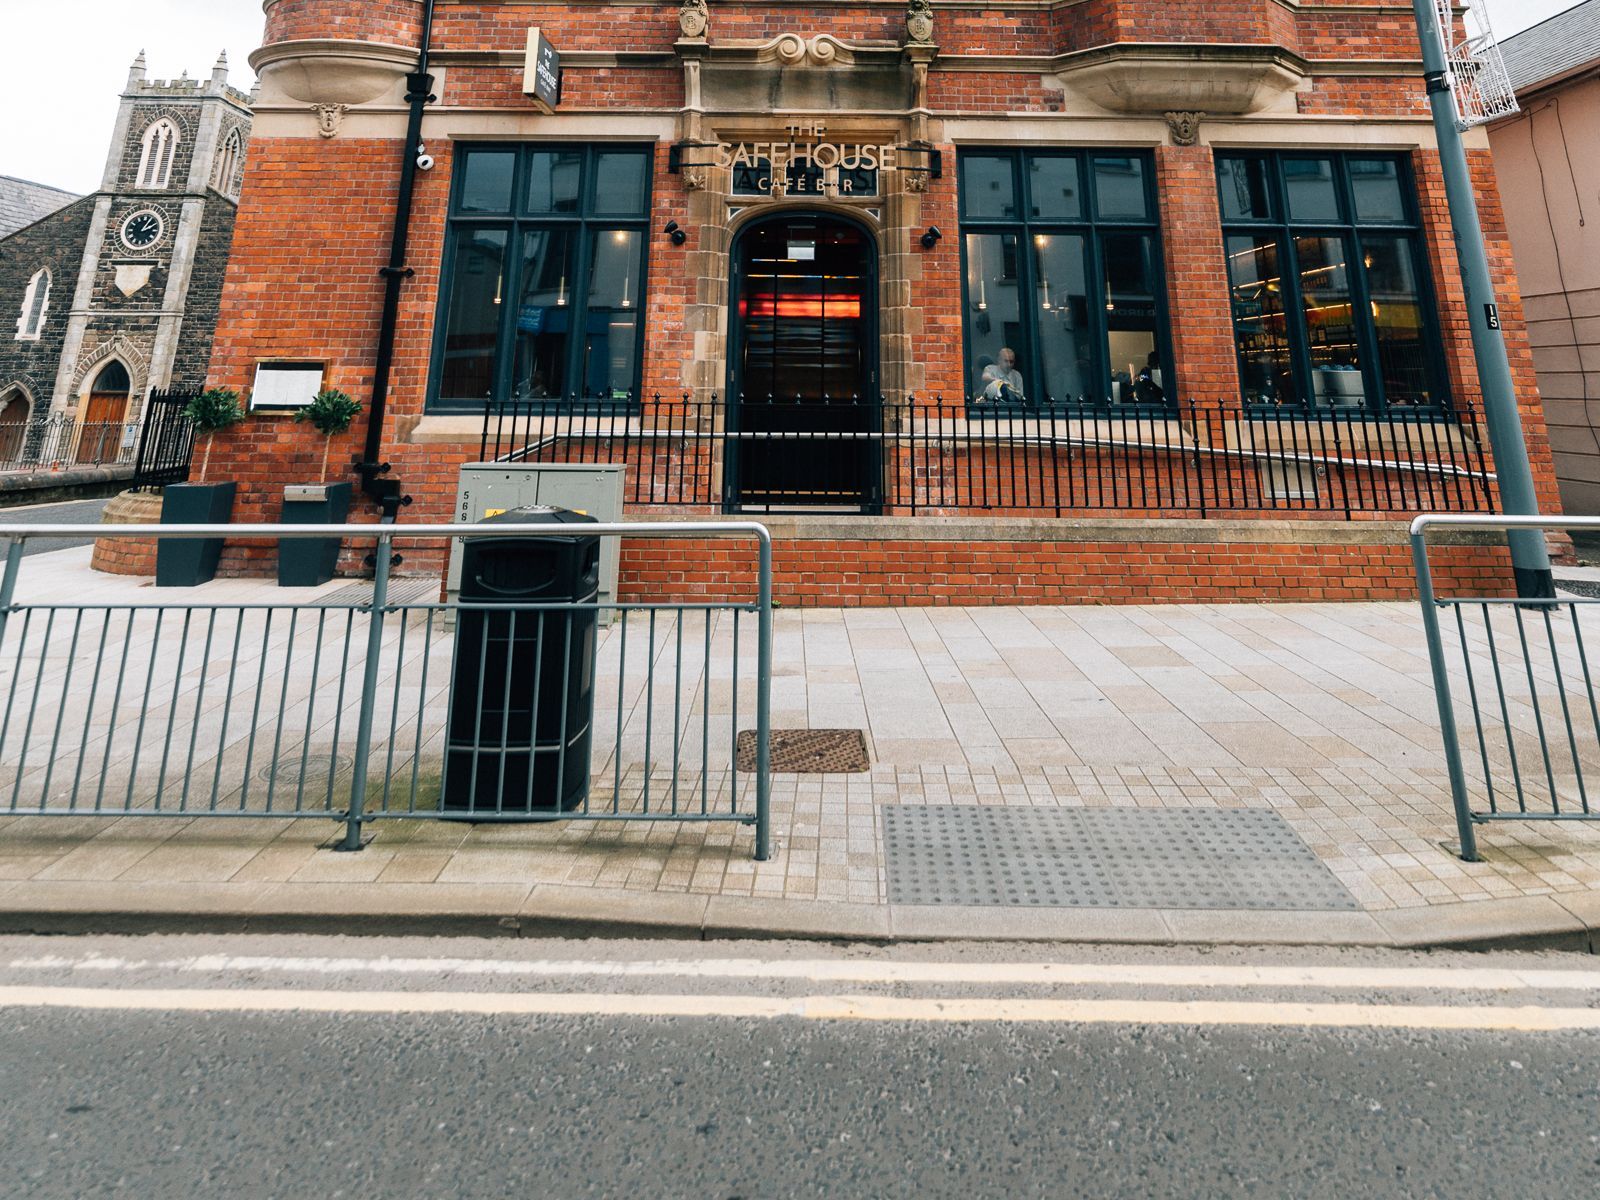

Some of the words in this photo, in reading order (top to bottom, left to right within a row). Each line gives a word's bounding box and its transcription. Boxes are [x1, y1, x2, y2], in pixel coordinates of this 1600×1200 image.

[788, 120, 825, 137] THE
[715, 141, 897, 171] SAFEHOUSE
[758, 174, 806, 191] CAFÉ
[816, 179, 853, 192] BAR
